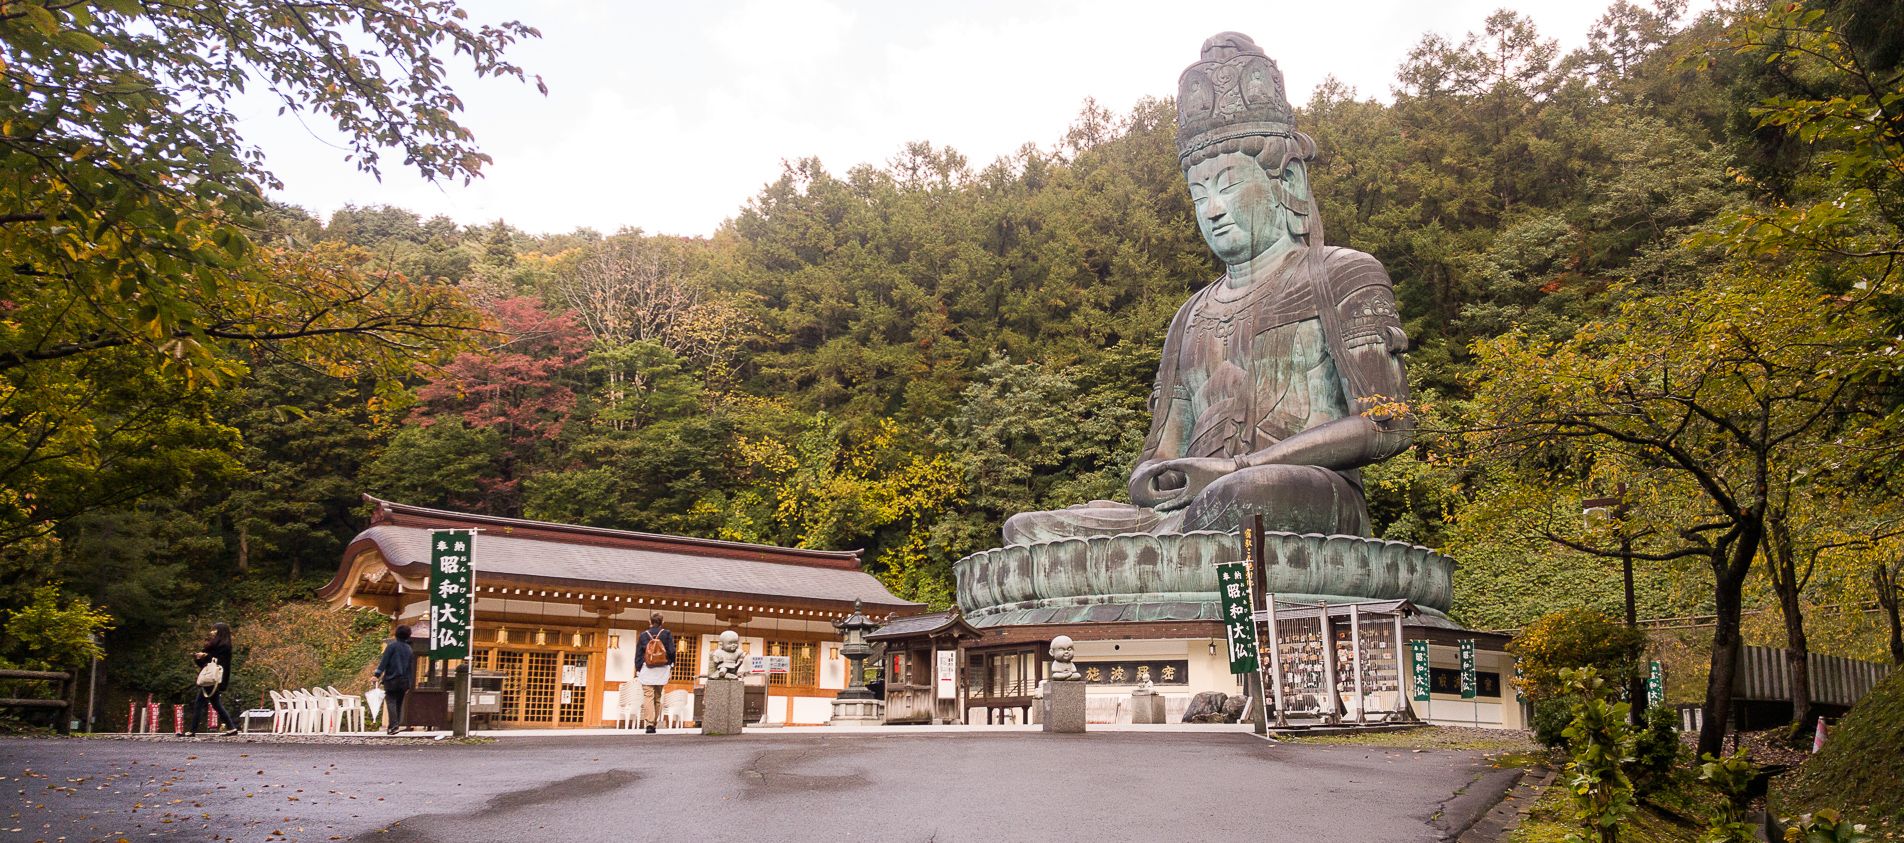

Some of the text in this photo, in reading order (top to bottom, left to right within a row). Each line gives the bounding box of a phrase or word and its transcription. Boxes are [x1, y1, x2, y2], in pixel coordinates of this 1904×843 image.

[436, 540, 466, 552] 奉納
[1222, 570, 1242, 581] 奉納
[438, 555, 460, 648] 昭和大仏
[1226, 583, 1248, 660] 昭和大仏
[1415, 652, 1426, 696] 昭和大仏
[1462, 651, 1470, 691] 昭和大仏
